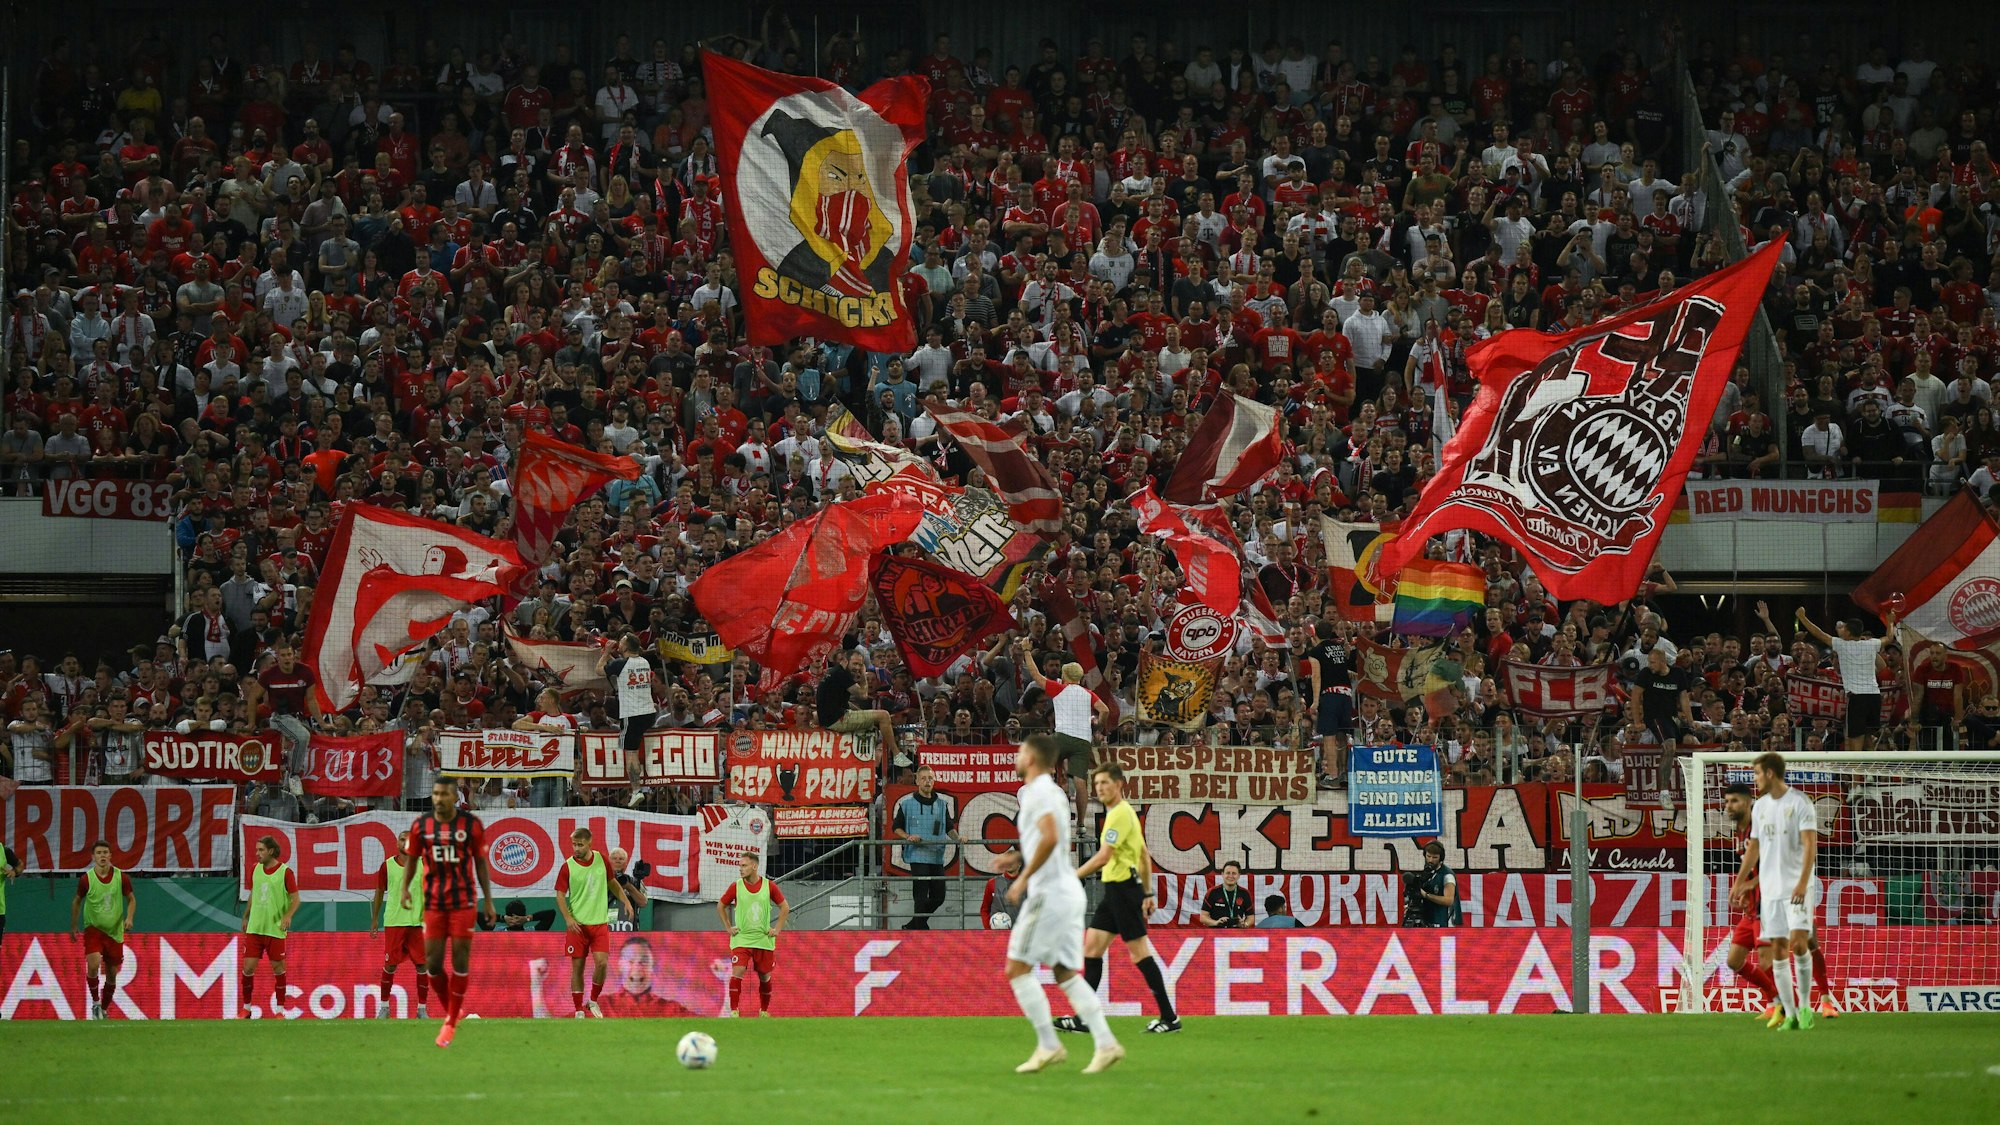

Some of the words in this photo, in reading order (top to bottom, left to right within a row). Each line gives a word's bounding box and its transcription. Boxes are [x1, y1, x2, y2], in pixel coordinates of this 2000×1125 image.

[46, 480, 117, 516] VGG
[1693, 487, 1743, 515] RED
[1185, 625, 1218, 641] qpb
[1174, 646, 1215, 660] BAYERN
[1507, 664, 1609, 711] FCB
[1788, 678, 1813, 698] NO
[1819, 686, 1846, 703] ON
[458, 738, 560, 769] REBELS
[761, 731, 853, 760] MUNICH'S
[146, 736, 278, 776] SÜDTIROL
[585, 735, 717, 778] COEGIO
[920, 753, 967, 765] FREIHEIT
[969, 752, 989, 765] FÜR
[1372, 749, 1418, 764] GUTE
[1625, 754, 1661, 768] DURC
[730, 765, 772, 798] RED
[805, 767, 873, 800] PRIDE
[932, 771, 974, 783] EUNDE
[976, 771, 991, 783] IM
[1190, 773, 1238, 800] BEI
[1248, 775, 1309, 800] UNS
[1355, 770, 1434, 785] FREUNDE
[1358, 791, 1399, 806] SIND
[1403, 791, 1432, 806] NIE
[1627, 791, 1640, 800] NO
[776, 809, 817, 820] NIEMALS
[1363, 812, 1432, 827] ALLEIN!
[0, 787, 235, 870] RDORF
[777, 825, 811, 836] IMMER
[892, 786, 1547, 877] CCKEA
[431, 844, 461, 864] ETL
[484, 816, 700, 893] OWE
[496, 842, 505, 854] FC
[503, 836, 533, 853] BAYERN
[705, 841, 723, 849] WIR
[725, 843, 760, 853] WOLLEN
[706, 848, 742, 859] ROT-WE
[496, 857, 533, 872] MÜNCHEN
[715, 857, 741, 867] TRIKO
[1607, 847, 1676, 870] Casuals
[1148, 872, 1399, 926] DABORN
[1033, 931, 1735, 1017] LYERALARM
[1659, 987, 1900, 1013] FYERARM
